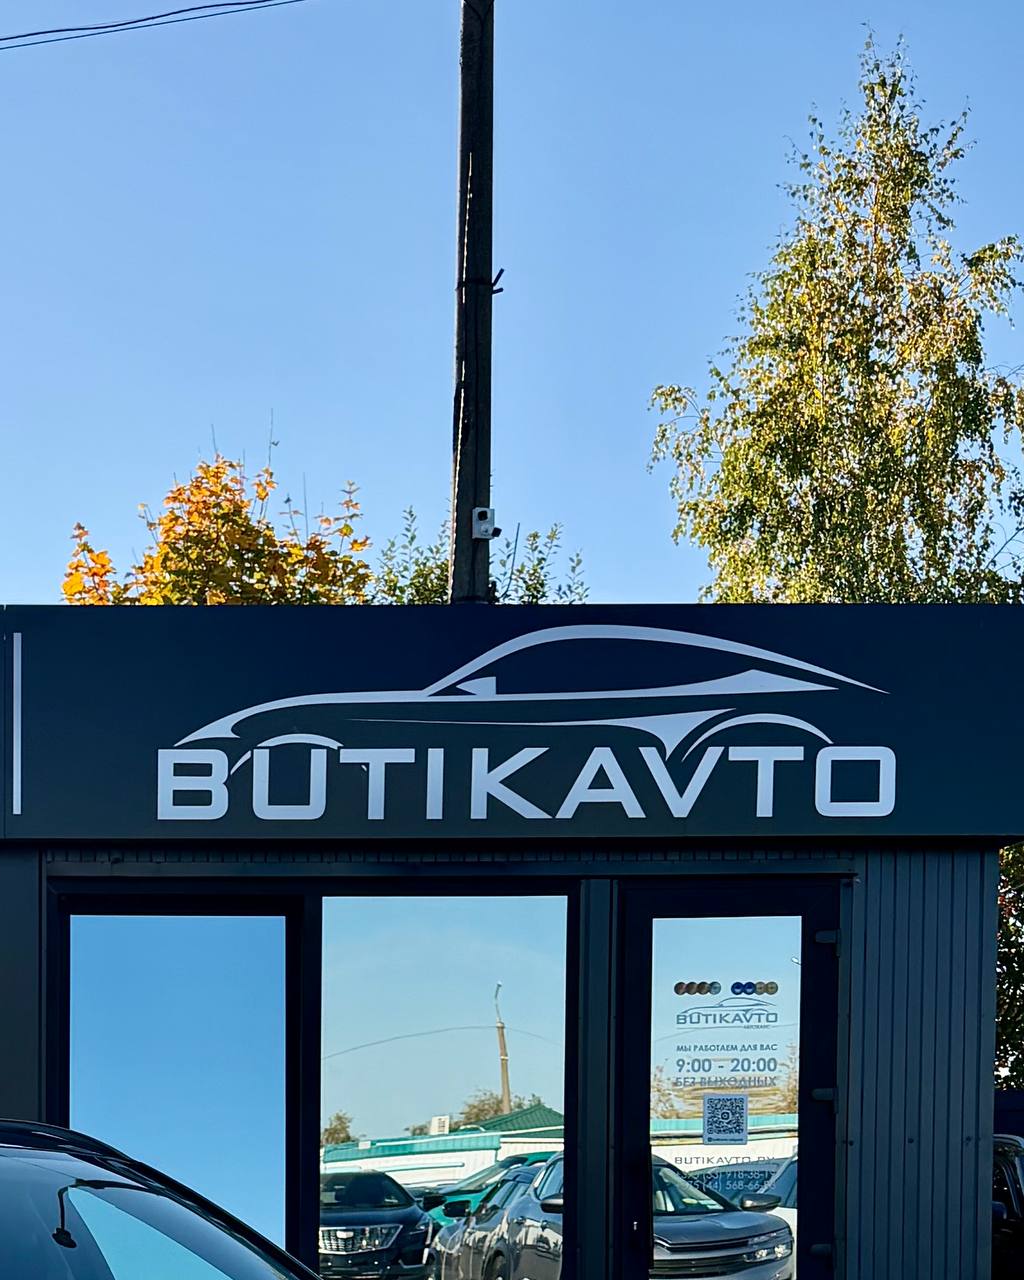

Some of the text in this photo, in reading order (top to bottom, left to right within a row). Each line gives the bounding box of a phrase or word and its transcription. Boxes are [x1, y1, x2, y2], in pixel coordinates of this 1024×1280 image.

[156, 744, 897, 821] BUTIKAVTO
[676, 1012, 778, 1025] BUTIKAVTO
[676, 1043, 778, 1052] МЫ РАБОТАЕМ ДЛЯ ВАС
[676, 1058, 712, 1073] 9:00
[730, 1058, 777, 1072] 20:00
[676, 1077, 696, 1087] БЕЗ
